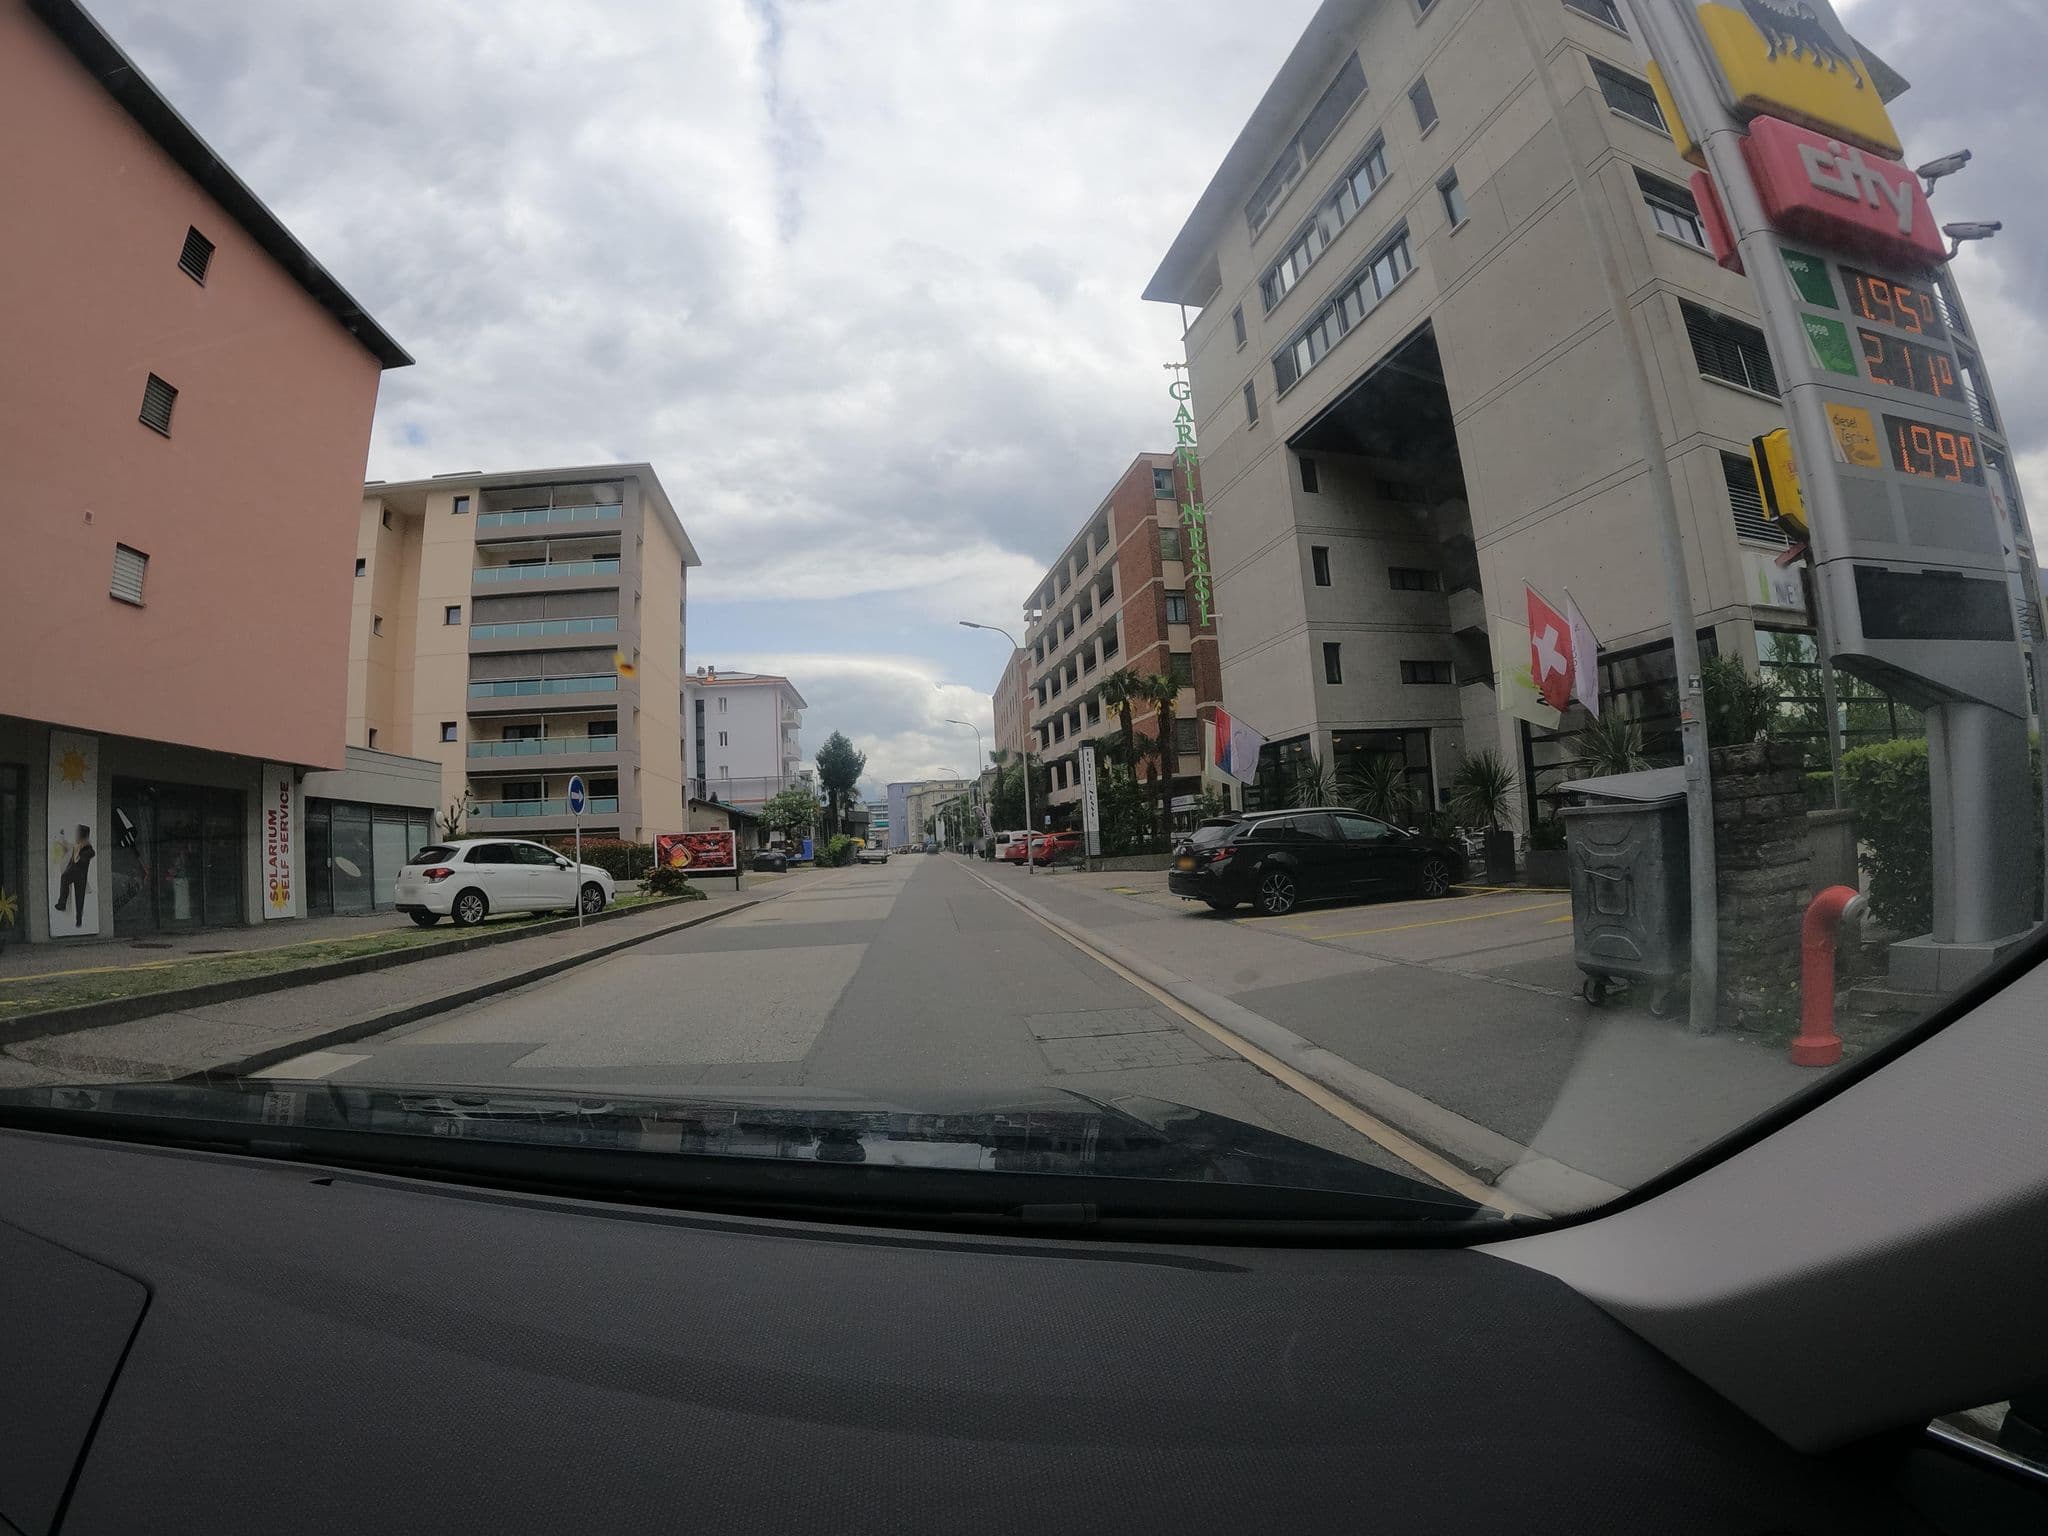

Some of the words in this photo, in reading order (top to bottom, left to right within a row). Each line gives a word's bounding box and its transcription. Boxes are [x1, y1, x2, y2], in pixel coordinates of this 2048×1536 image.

[1798, 141, 1913, 235] city
[1169, 381, 1198, 491] GARNI
[1832, 415, 1857, 428] diesel
[1181, 502, 1211, 627] NESSI
[268, 809, 279, 902] SOLARIUM
[280, 781, 289, 854] SERVICE
[280, 863, 290, 902] SELF
